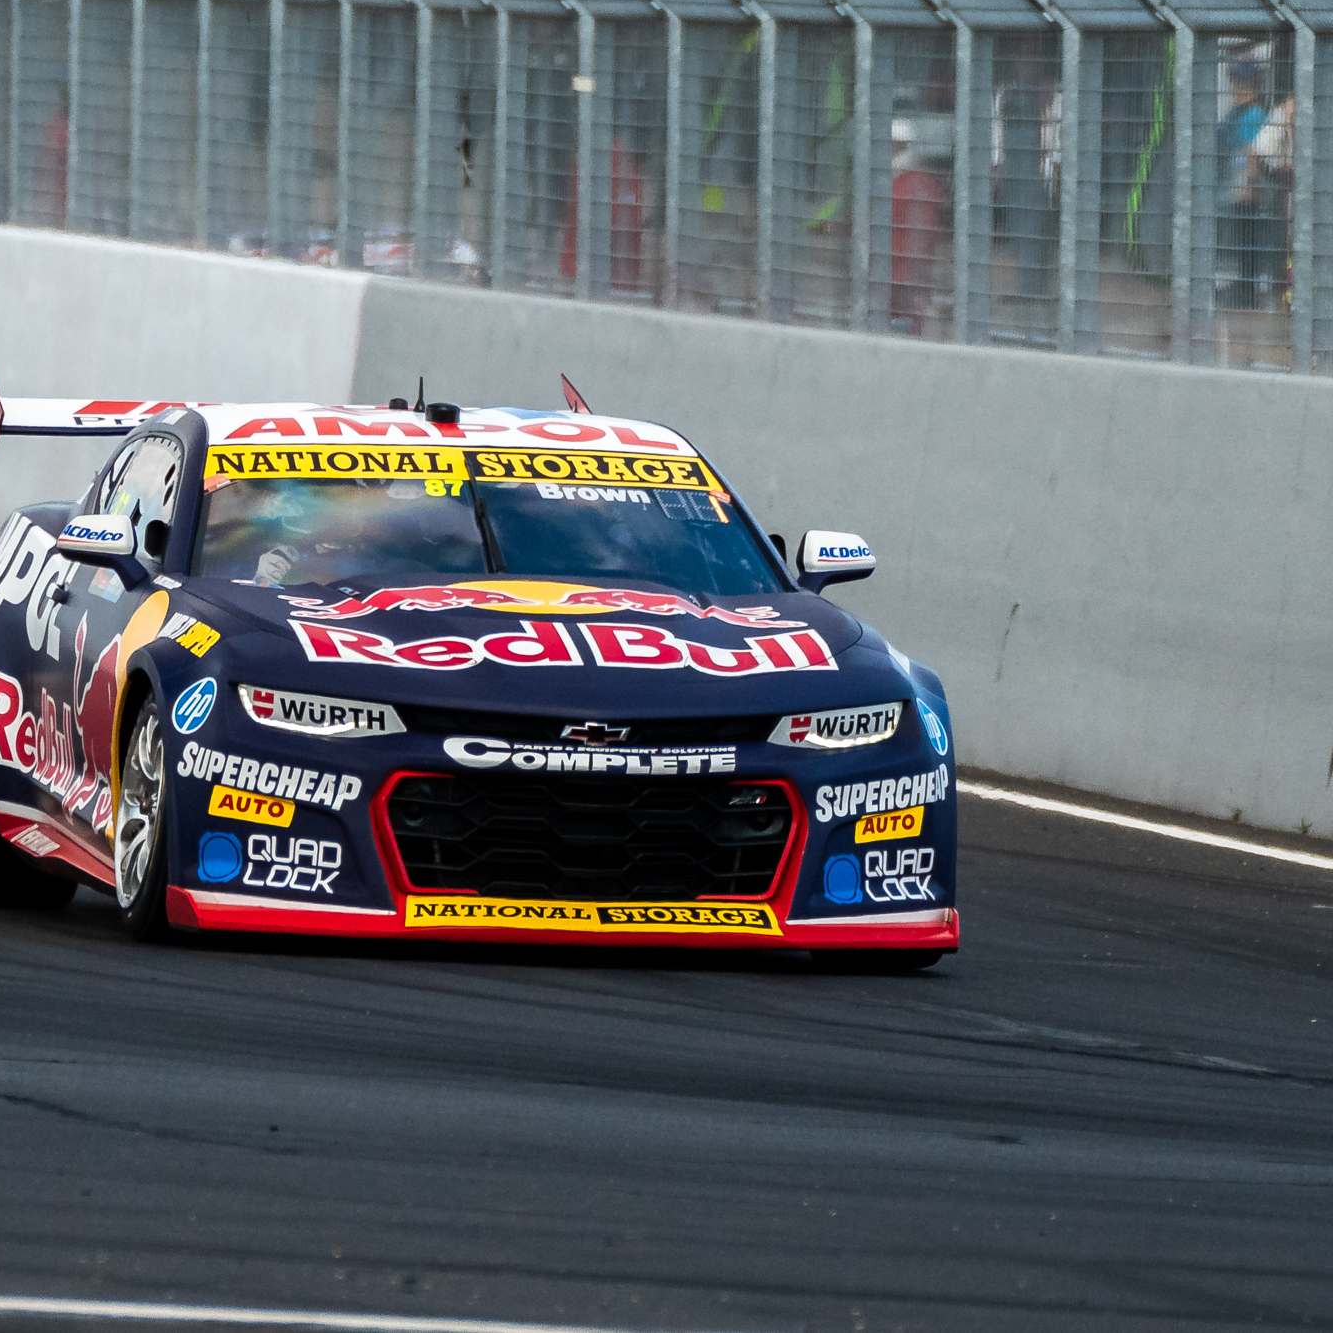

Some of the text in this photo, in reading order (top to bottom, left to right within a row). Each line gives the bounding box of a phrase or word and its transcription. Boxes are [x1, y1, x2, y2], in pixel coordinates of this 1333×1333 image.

[223, 415, 679, 451] AMPOL
[215, 451, 699, 486] NATIONAL STORAGE
[424, 480, 464, 497] 87
[536, 482, 651, 504] Brown
[62, 524, 124, 542] ACDelco
[288, 620, 839, 676] Red Bull
[661, 745, 737, 755] SOLUTIONS
[177, 741, 363, 812] SUPERCHEAP
[218, 793, 286, 819] AUTO
[815, 763, 949, 823] SUPERCHEAP
[861, 813, 916, 836] AUTO
[247, 833, 342, 869] QUAD
[864, 847, 935, 877] QUAD
[242, 866, 340, 894] LOCK
[865, 875, 936, 902] LOCK
[412, 902, 765, 928] NATIONAL STORAGE
